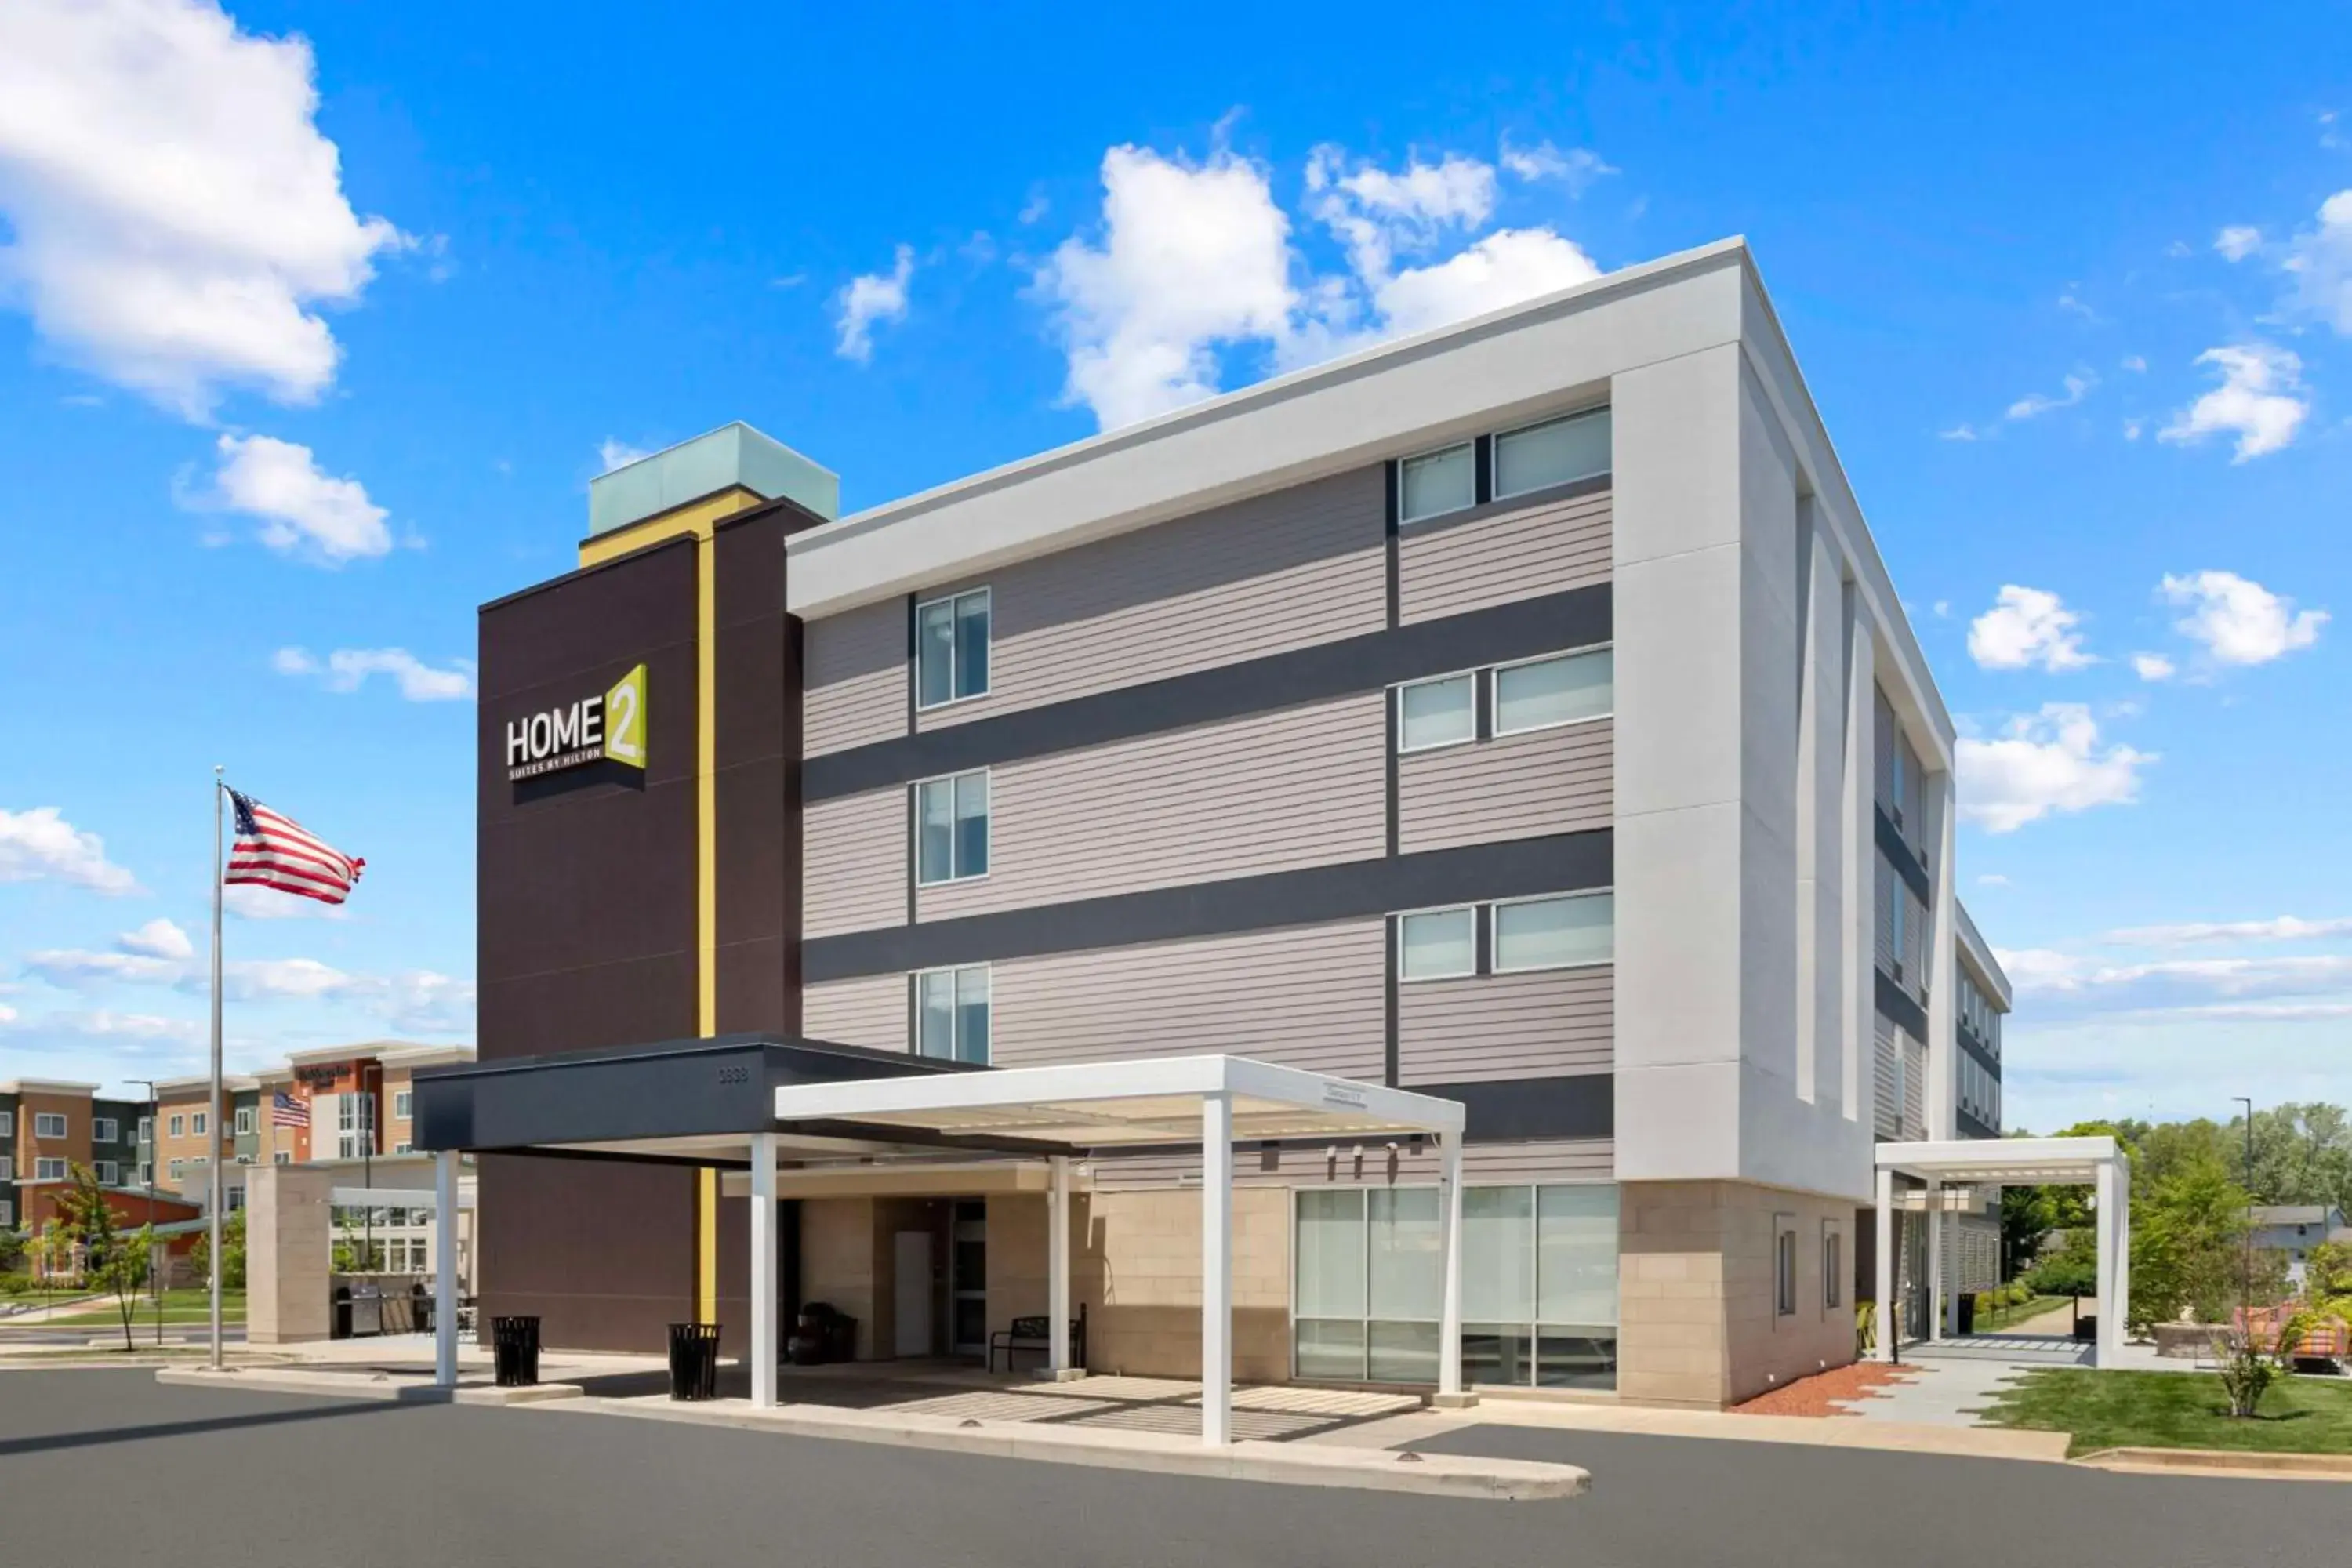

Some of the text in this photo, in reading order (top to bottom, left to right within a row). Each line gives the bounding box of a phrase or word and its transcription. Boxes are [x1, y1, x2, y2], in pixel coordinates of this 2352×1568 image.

[509, 748, 601, 780] SUITES BY HILTON
